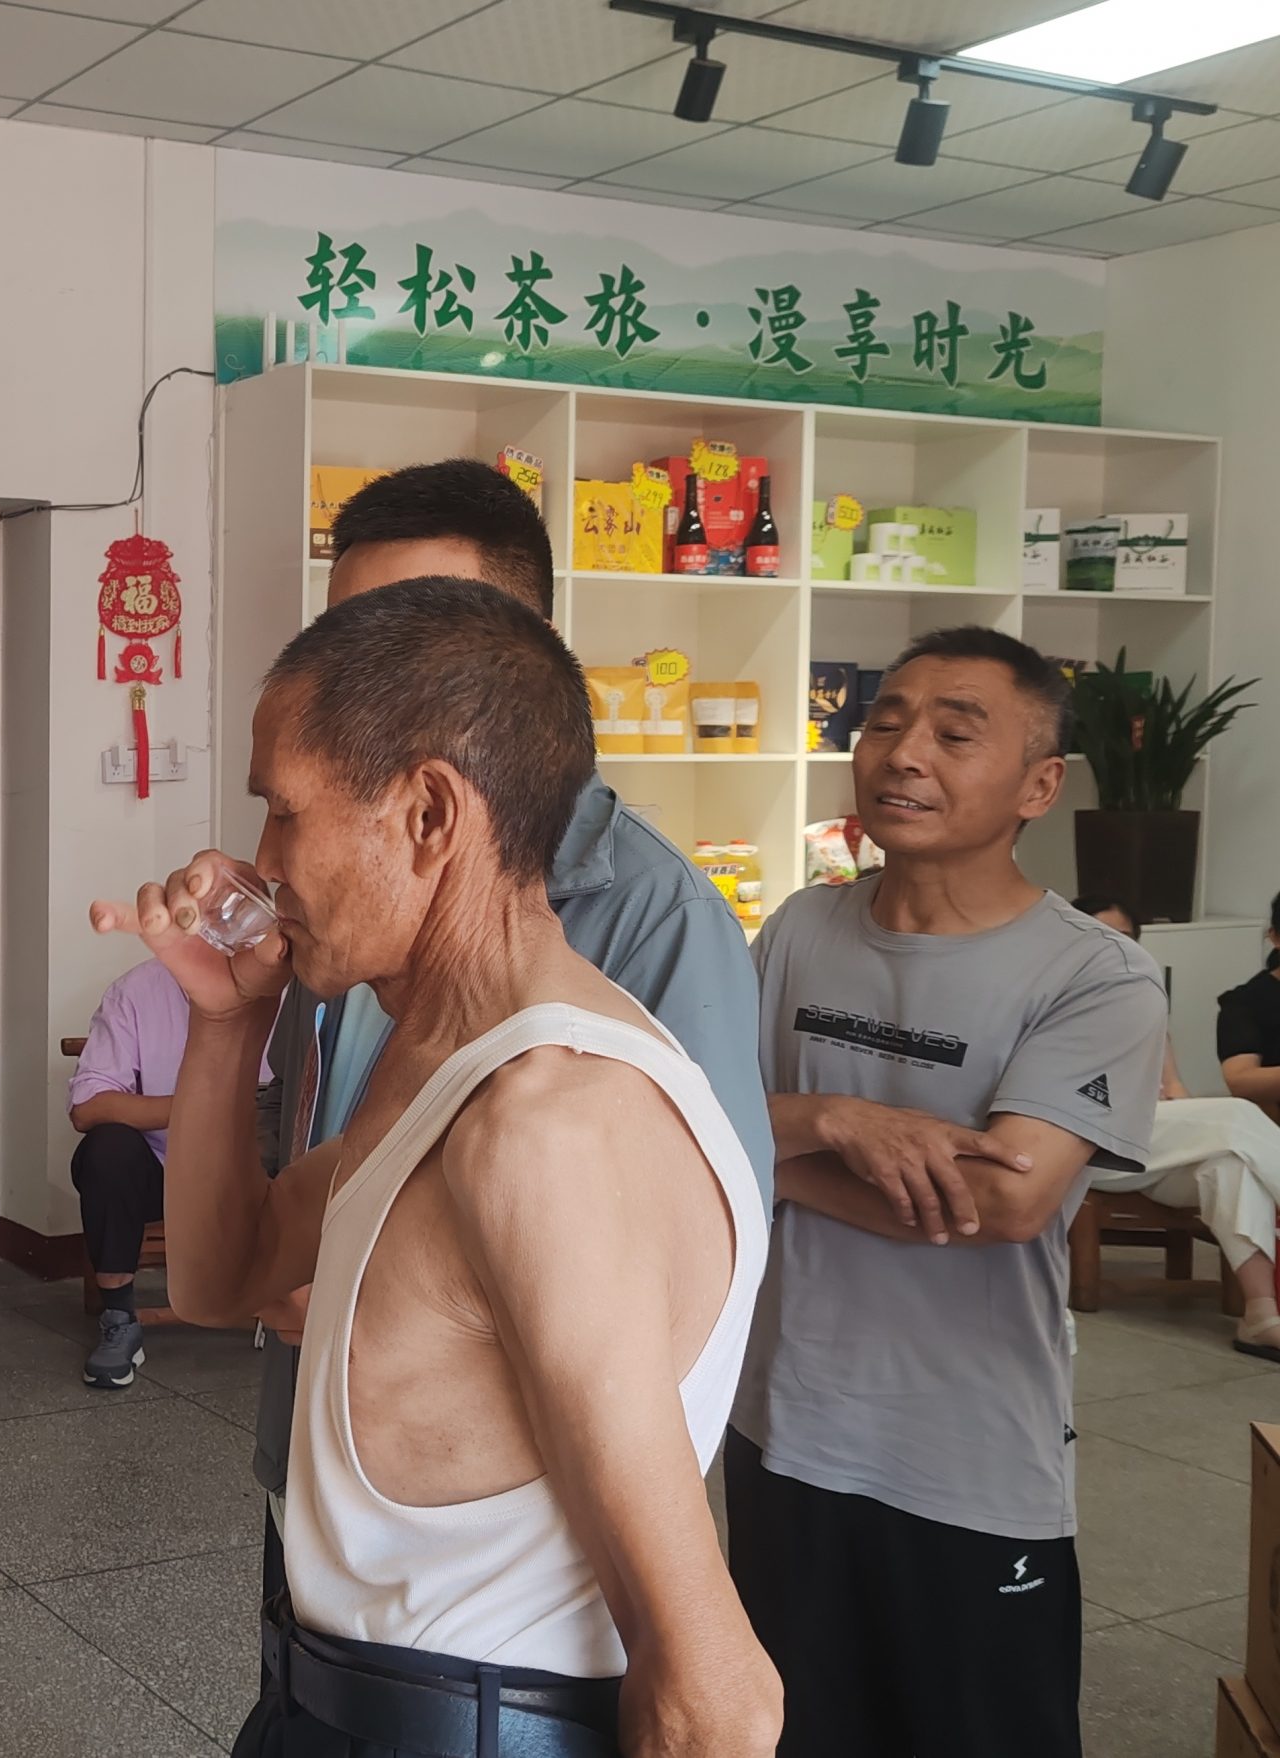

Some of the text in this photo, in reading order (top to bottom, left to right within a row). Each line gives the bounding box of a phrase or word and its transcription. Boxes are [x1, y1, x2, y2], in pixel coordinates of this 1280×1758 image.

[297, 232, 1050, 390] 轻松茶旅·漫享时光
[120, 574, 159, 615] 福
[656, 662, 677, 675] 100
[805, 1004, 961, 1050] SEPTWOLVES
[1087, 1086, 1106, 1102] SW
